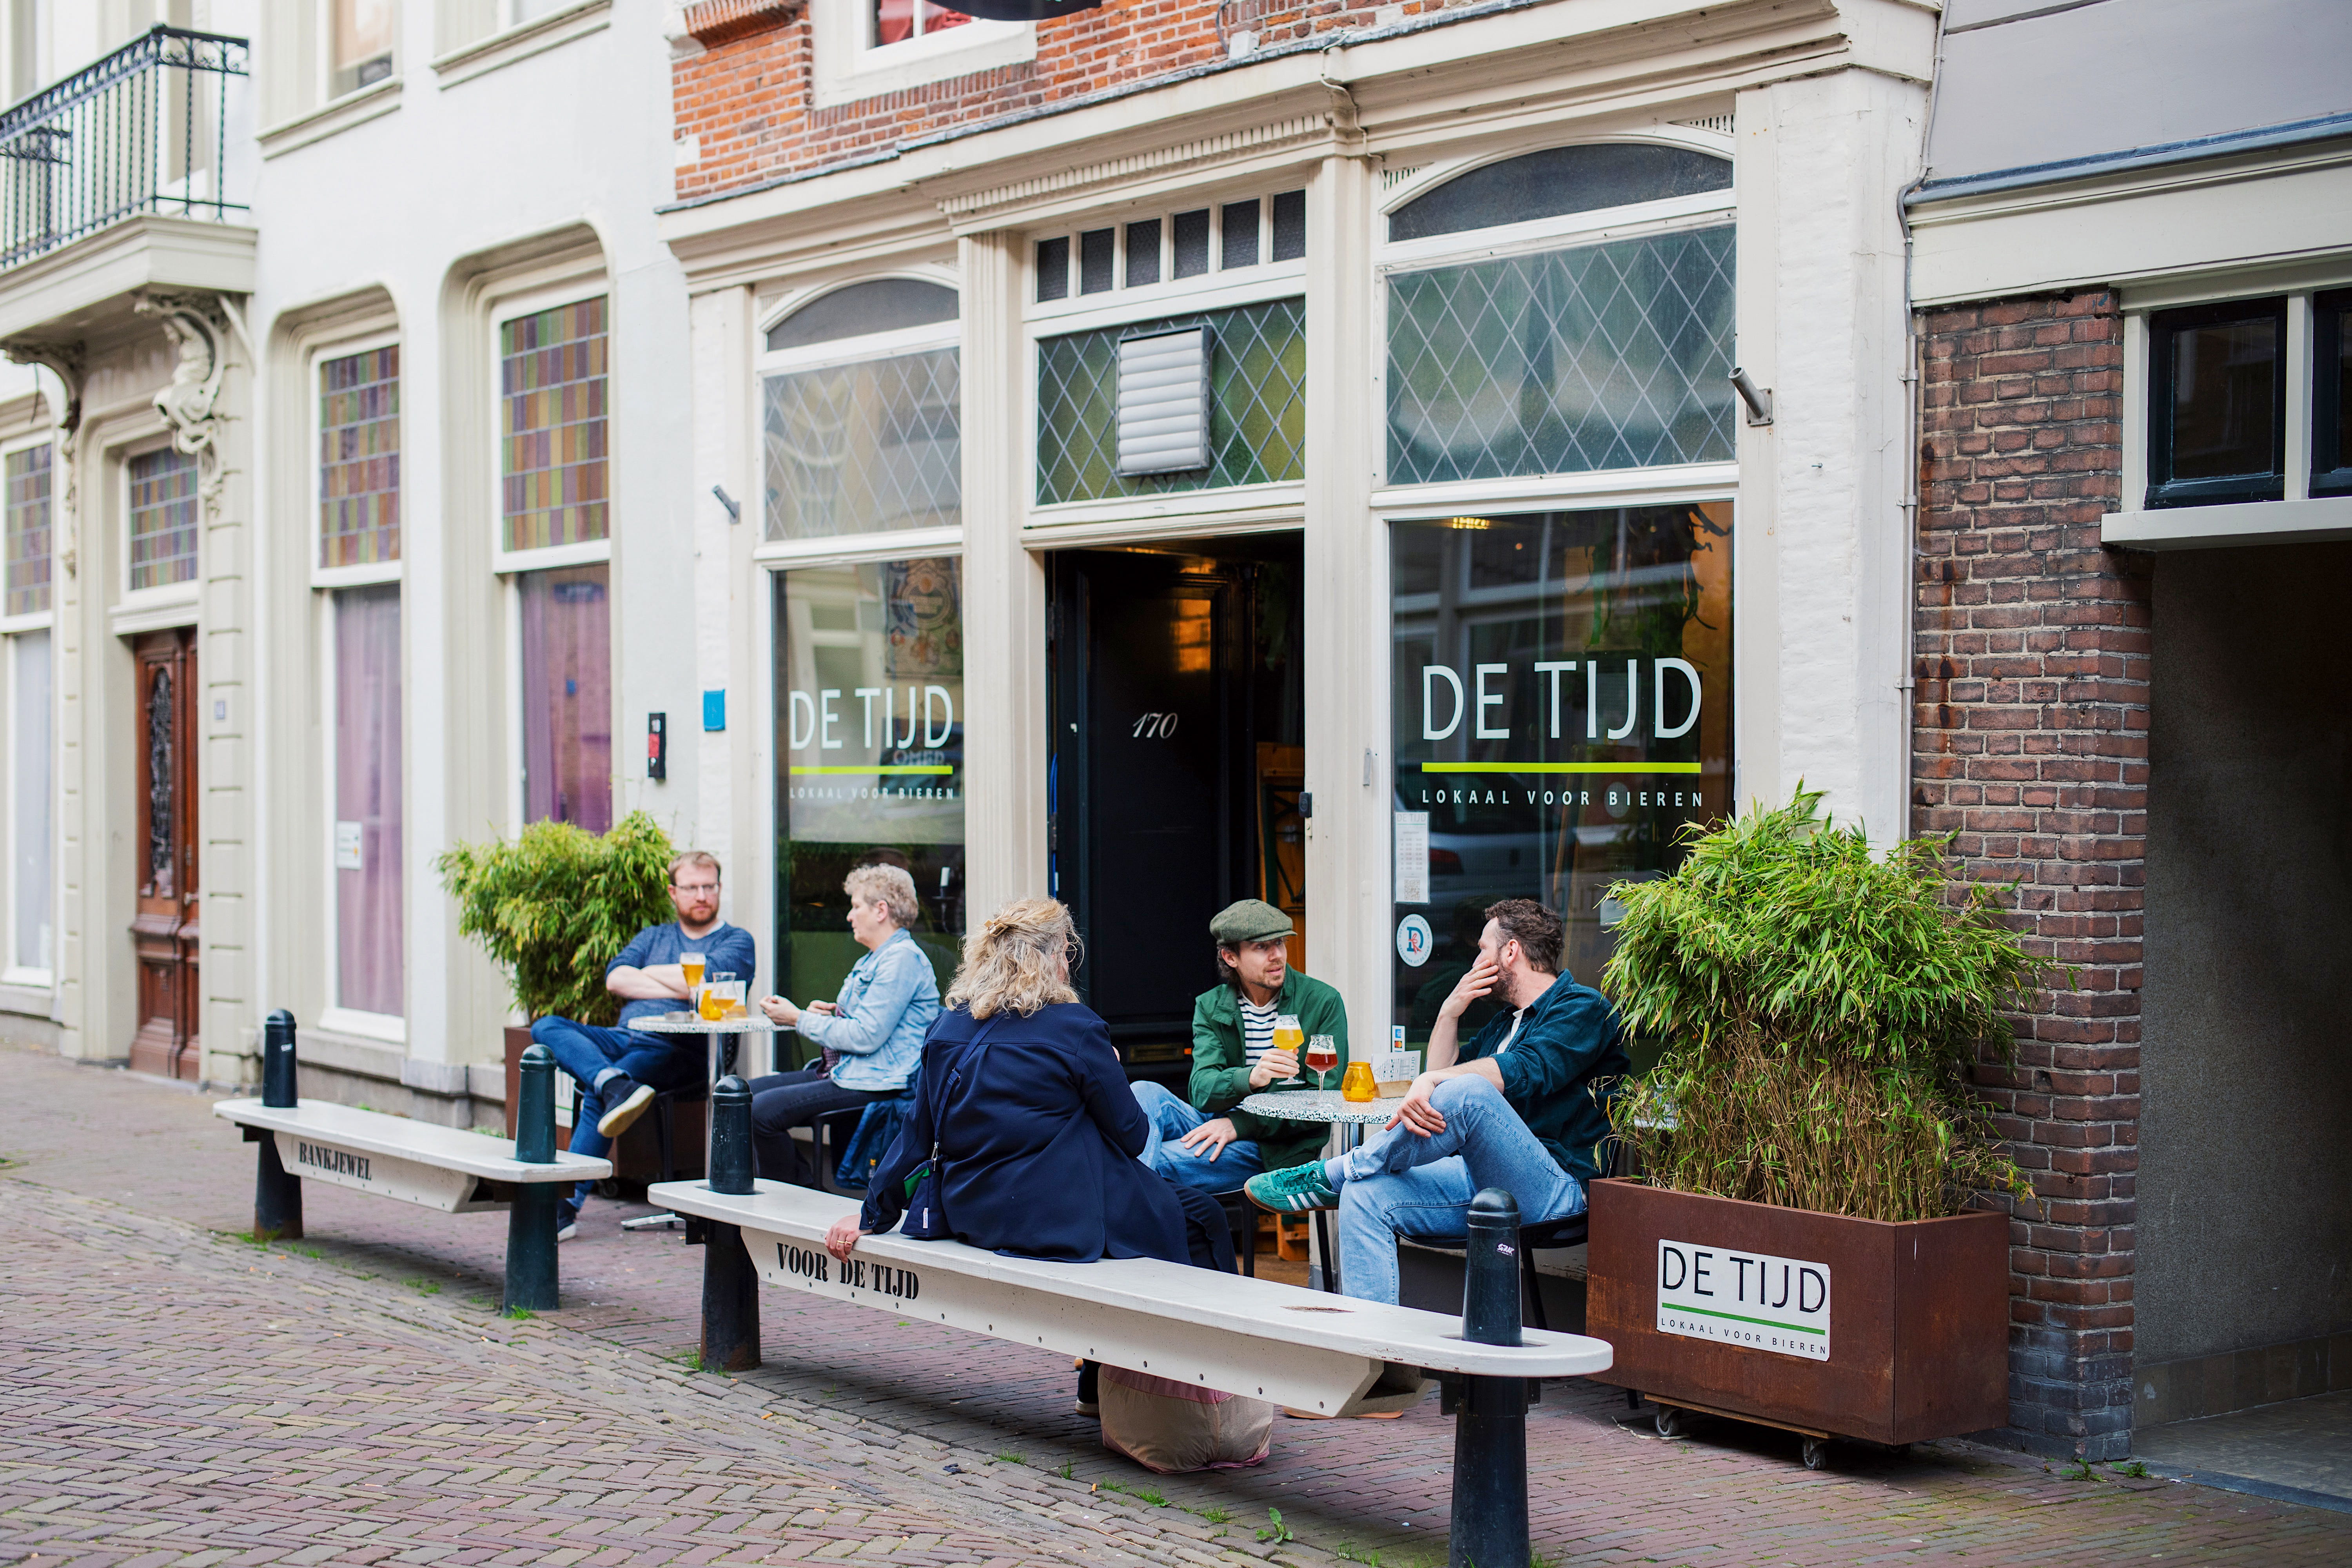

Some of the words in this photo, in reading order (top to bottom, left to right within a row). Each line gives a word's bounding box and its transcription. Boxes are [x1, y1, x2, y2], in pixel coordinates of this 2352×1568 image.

[789, 689, 842, 750] DE
[855, 685, 954, 749] TIJD
[1423, 663, 1510, 740] DE
[1534, 659, 1702, 740] TIJD
[1132, 712, 1178, 739] 170
[789, 786, 844, 800] LOKAAL
[851, 786, 889, 800] VOOR
[899, 787, 953, 800] BIEREN
[1422, 789, 1510, 804] LOKAAL
[1527, 790, 1590, 806] VOOR
[1609, 791, 1702, 807] BIEREN
[1397, 813, 1407, 822] DE
[1409, 813, 1426, 822] TIJD
[299, 1141, 372, 1181] BANKJEWEL
[777, 1242, 829, 1283] VOOR
[839, 1258, 866, 1289] DE
[871, 1263, 919, 1300] TIJD
[1662, 1246, 1713, 1297] DE
[1729, 1256, 1826, 1313] TIJD
[1661, 1318, 1713, 1334] LOKAAL
[1724, 1329, 1761, 1343] VOOR
[1772, 1338, 1826, 1354] BIEREN
